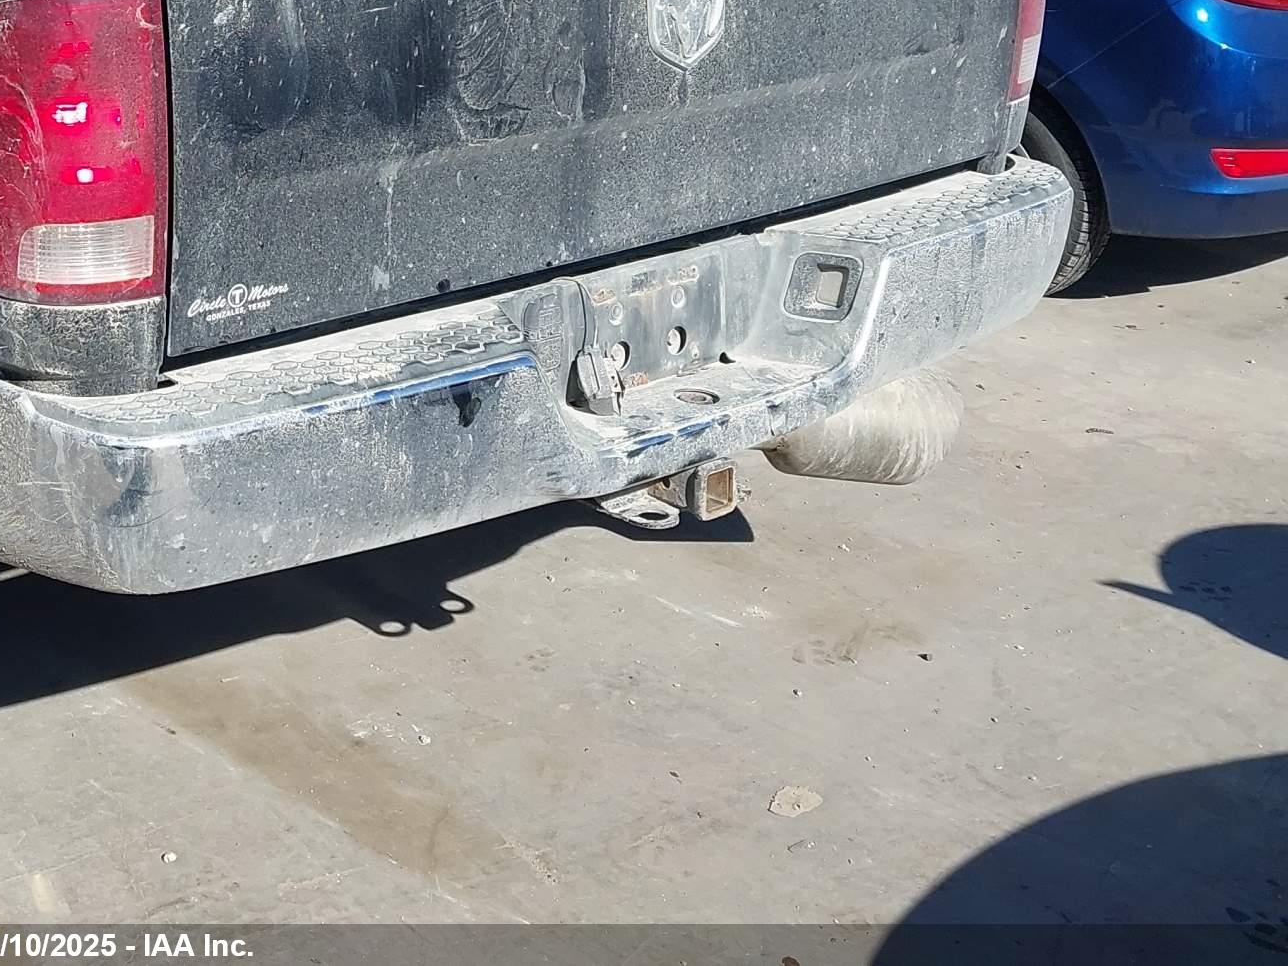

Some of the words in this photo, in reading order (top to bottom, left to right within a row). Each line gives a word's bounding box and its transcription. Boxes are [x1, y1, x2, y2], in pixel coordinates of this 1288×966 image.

[187, 295, 227, 318] Circle
[248, 282, 289, 301] Motors
[247, 299, 272, 313] TEXAS
